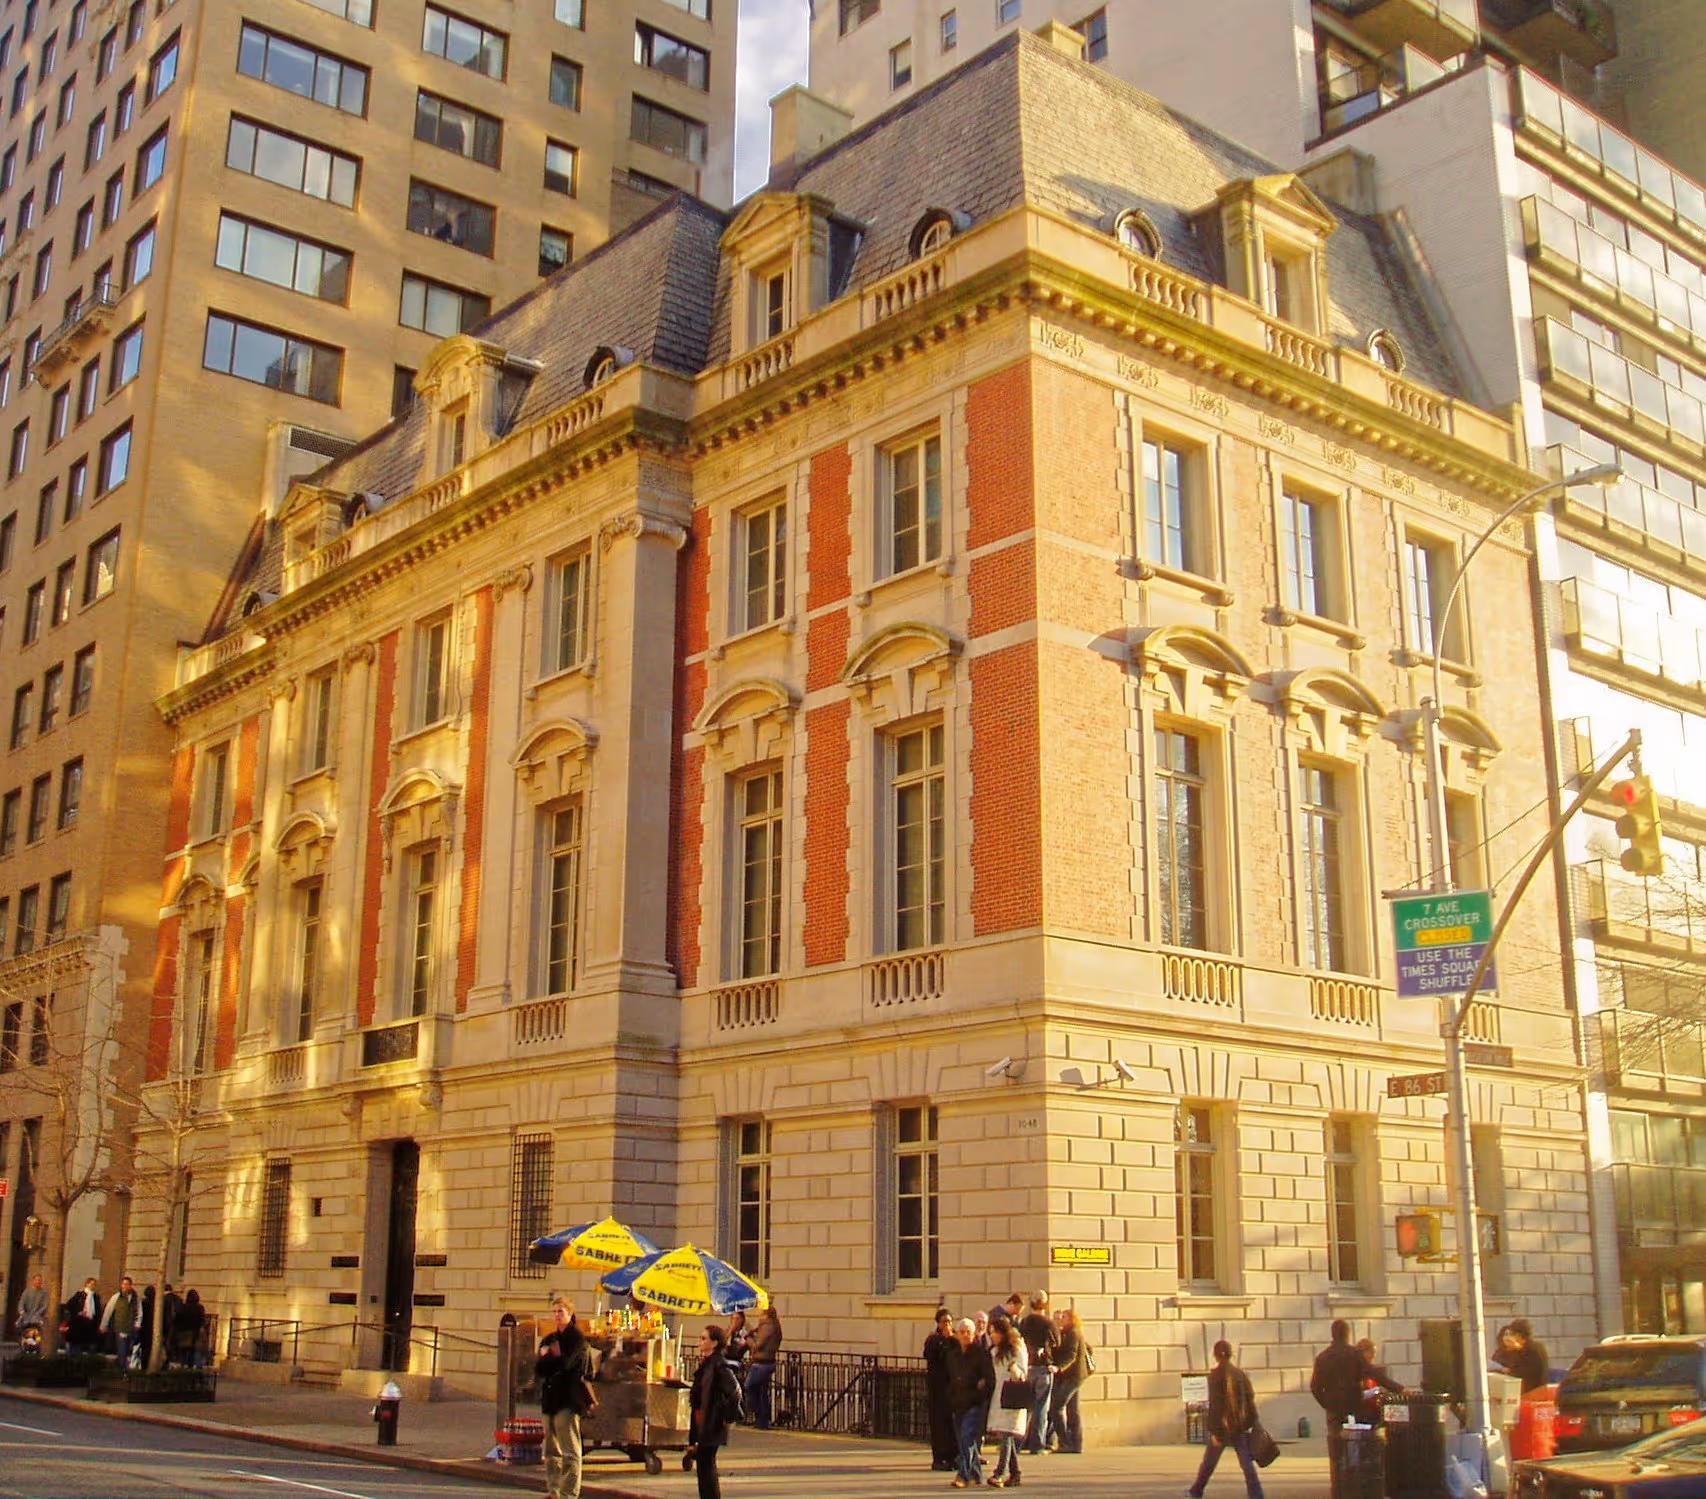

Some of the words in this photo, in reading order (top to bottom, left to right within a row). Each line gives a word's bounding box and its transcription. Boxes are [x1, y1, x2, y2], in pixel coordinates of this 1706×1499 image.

[1423, 904, 1430, 914] 7
[1436, 901, 1459, 913] AVE
[1404, 912, 1480, 930] CROSSOVER
[1417, 950, 1441, 963] USE
[1447, 947, 1472, 959] THE
[1401, 964, 1436, 978] TIMES
[1391, 1080, 1398, 1095] E
[1405, 1079, 1421, 1094] 86
[1426, 1077, 1441, 1092] ST
[638, 1286, 706, 1309] SABRETT
